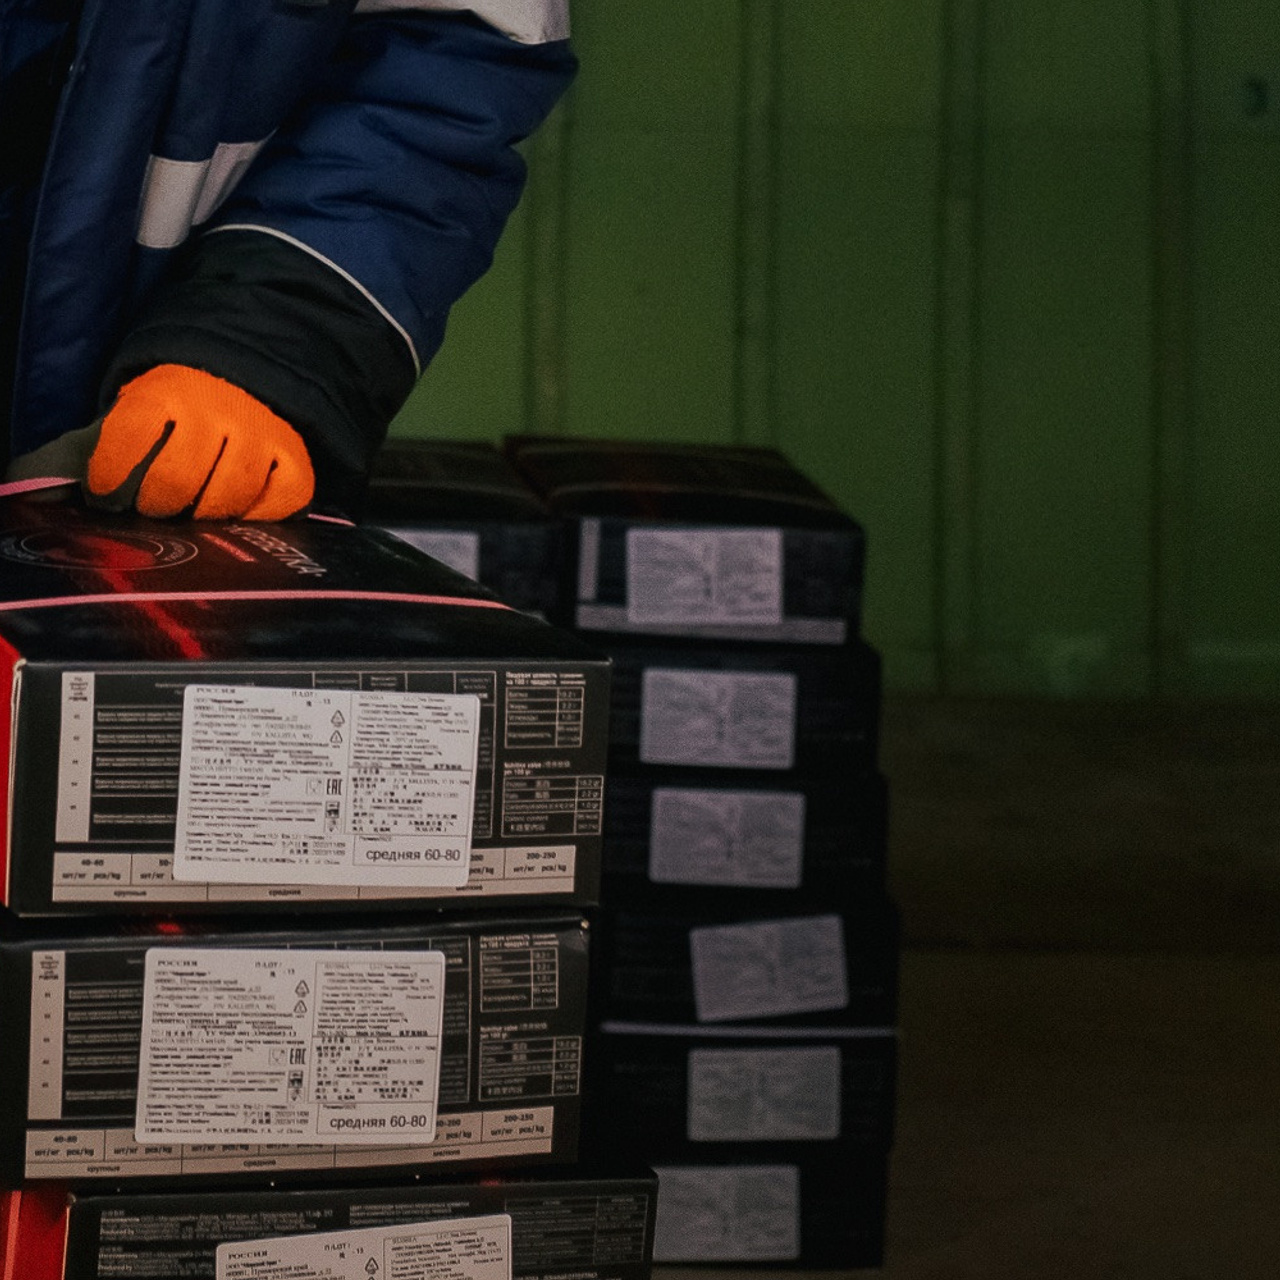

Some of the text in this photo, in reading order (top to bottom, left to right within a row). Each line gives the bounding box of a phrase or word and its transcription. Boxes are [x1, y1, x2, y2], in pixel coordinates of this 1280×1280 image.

[366, 848, 420, 862] средняя
[424, 849, 461, 861] 60-80
[330, 1114, 427, 1129] средняя 60-80
